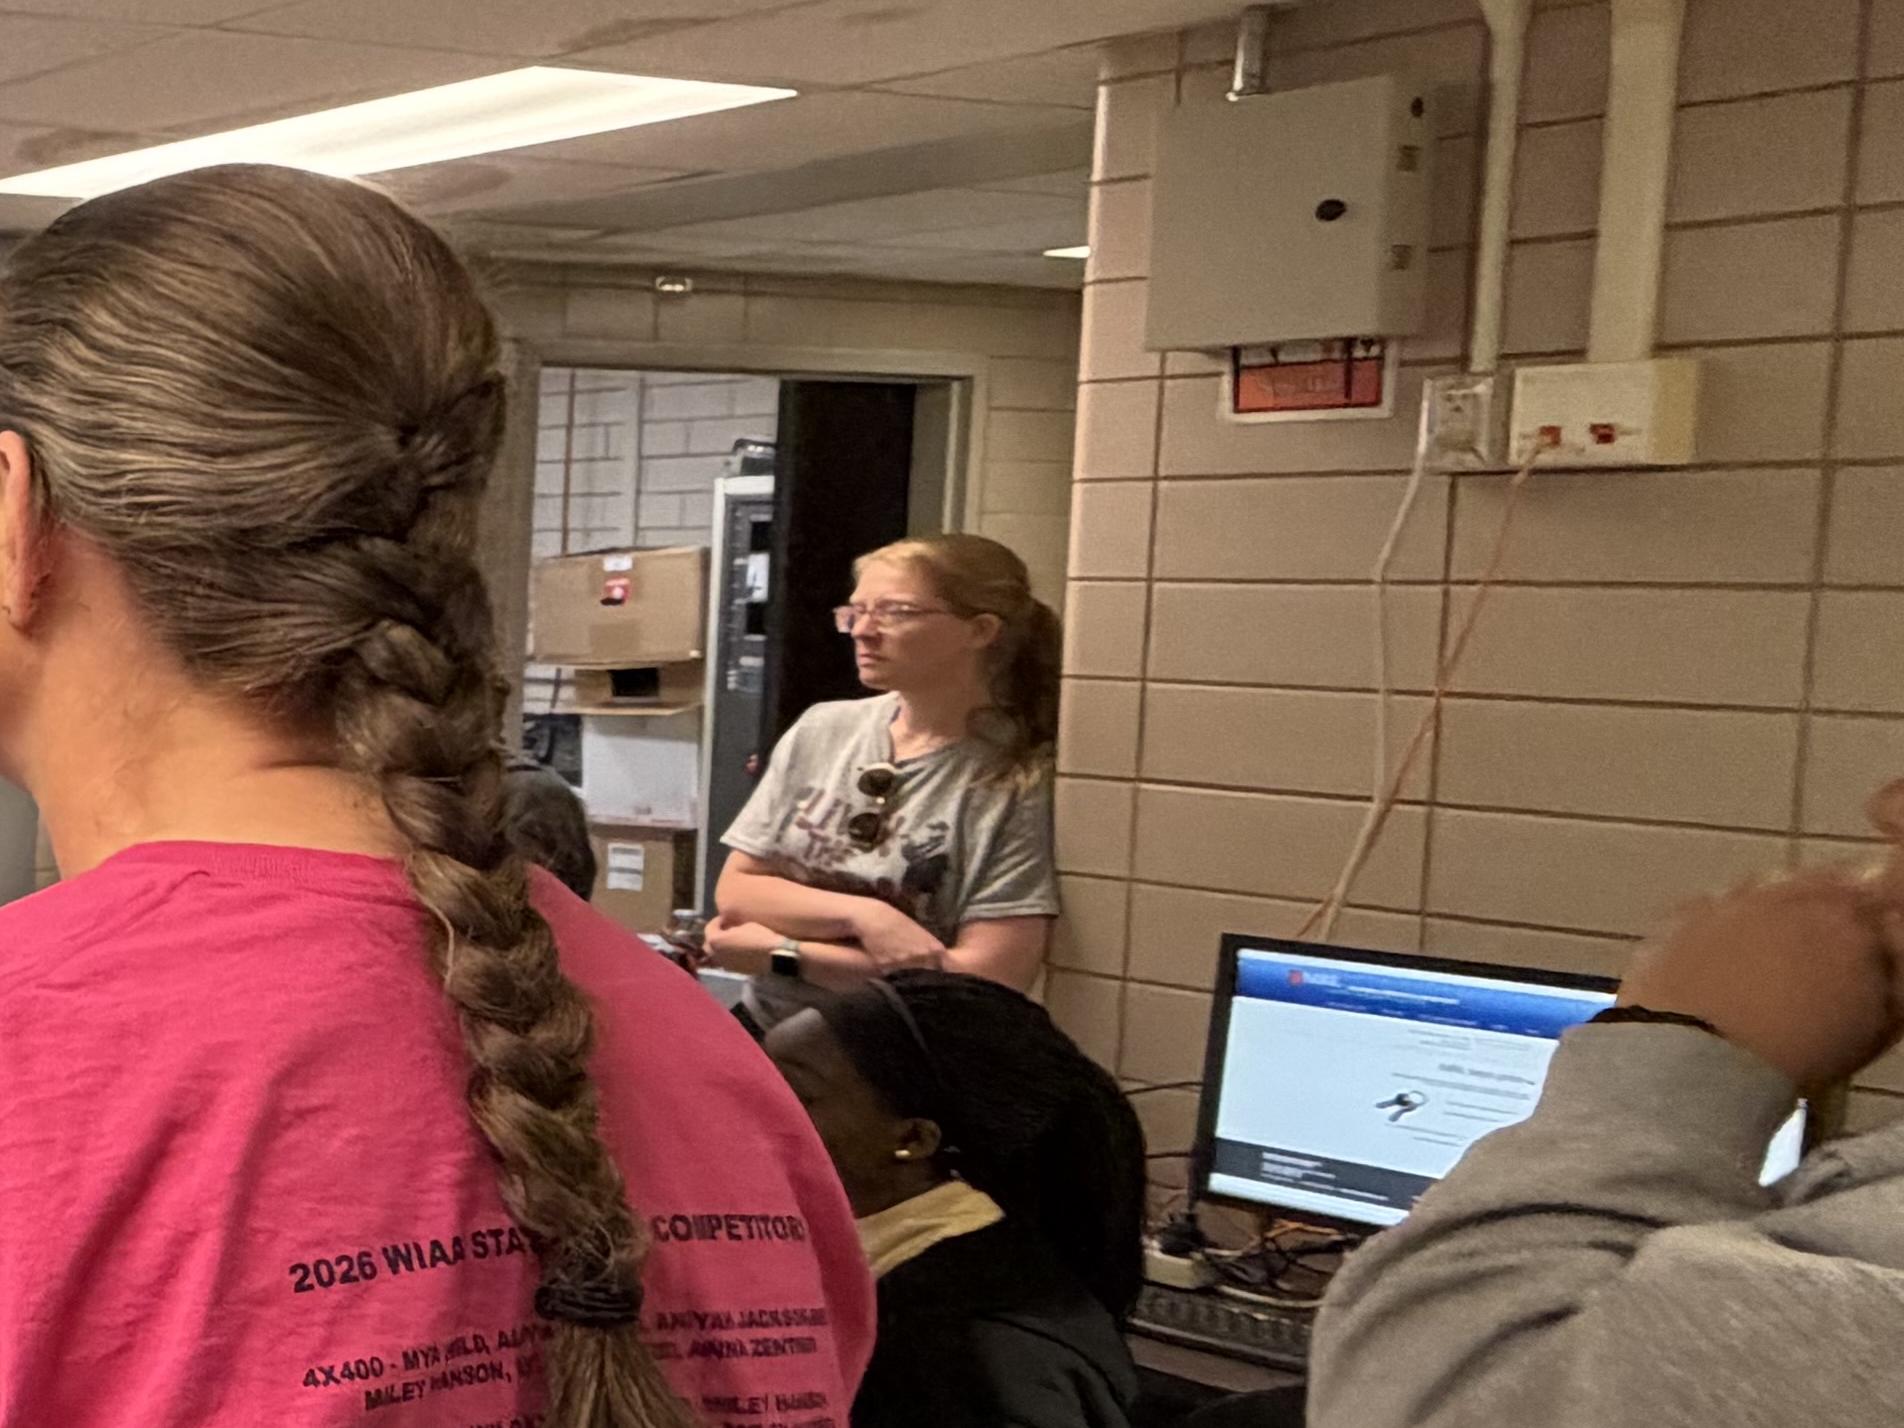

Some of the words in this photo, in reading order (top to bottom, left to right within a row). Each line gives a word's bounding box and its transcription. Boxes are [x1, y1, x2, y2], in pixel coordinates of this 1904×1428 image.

[288, 1250, 379, 1294] 2026
[381, 1234, 466, 1276] WIAA
[470, 1226, 542, 1260] STA
